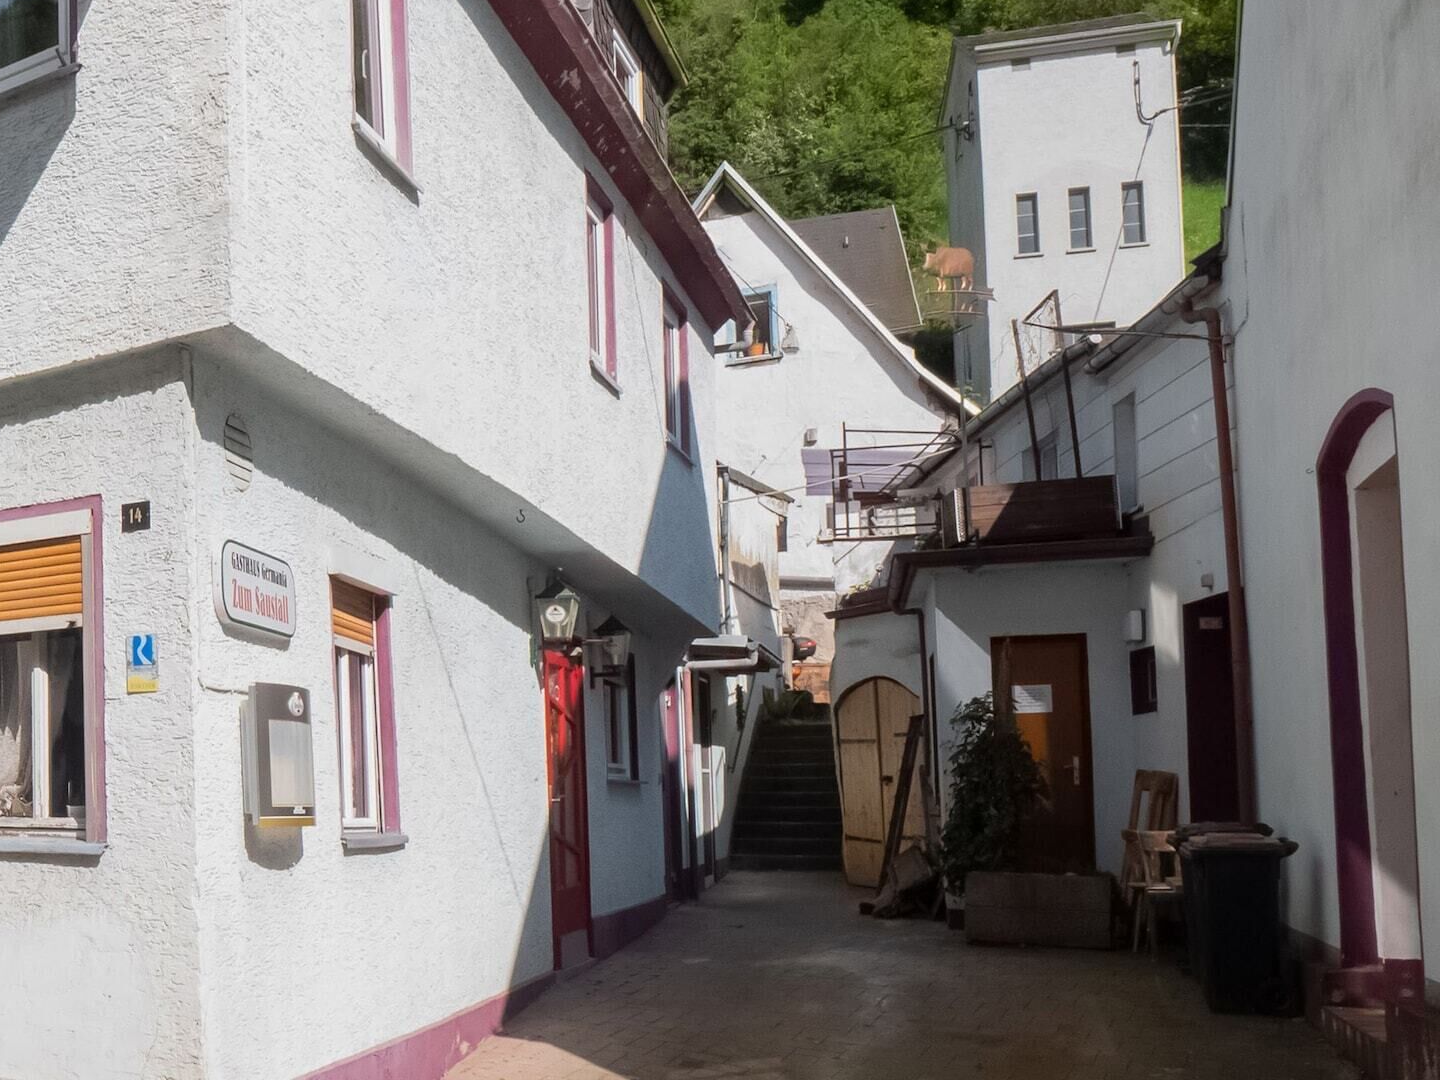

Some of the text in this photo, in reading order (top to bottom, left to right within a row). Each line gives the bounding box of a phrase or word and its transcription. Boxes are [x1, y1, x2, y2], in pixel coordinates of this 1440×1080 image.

[129, 507, 142, 524] 14
[231, 551, 287, 588] GASTHAUS Germania
[232, 578, 289, 624] Zum Saustall
